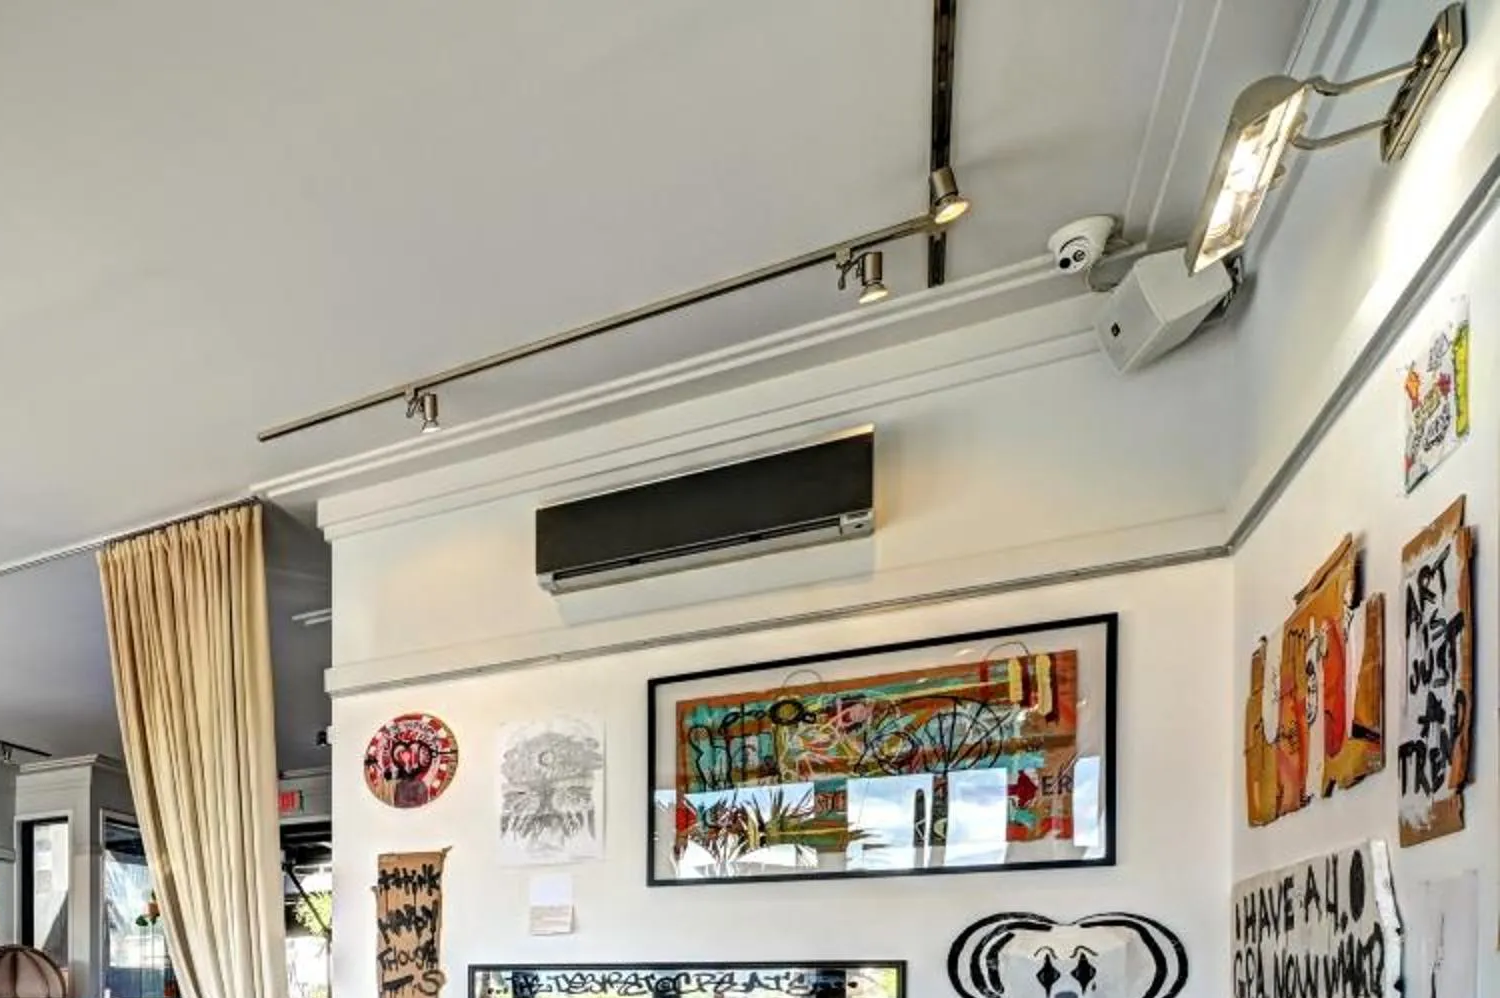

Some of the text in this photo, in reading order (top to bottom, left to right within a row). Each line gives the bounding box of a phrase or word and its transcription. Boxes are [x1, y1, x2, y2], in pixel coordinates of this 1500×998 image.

[1405, 543, 1451, 638] ART
[1422, 609, 1447, 652] IS
[1409, 611, 1465, 695] JUST
[1243, 876, 1295, 945] HAVE
[1304, 864, 1323, 924] A
